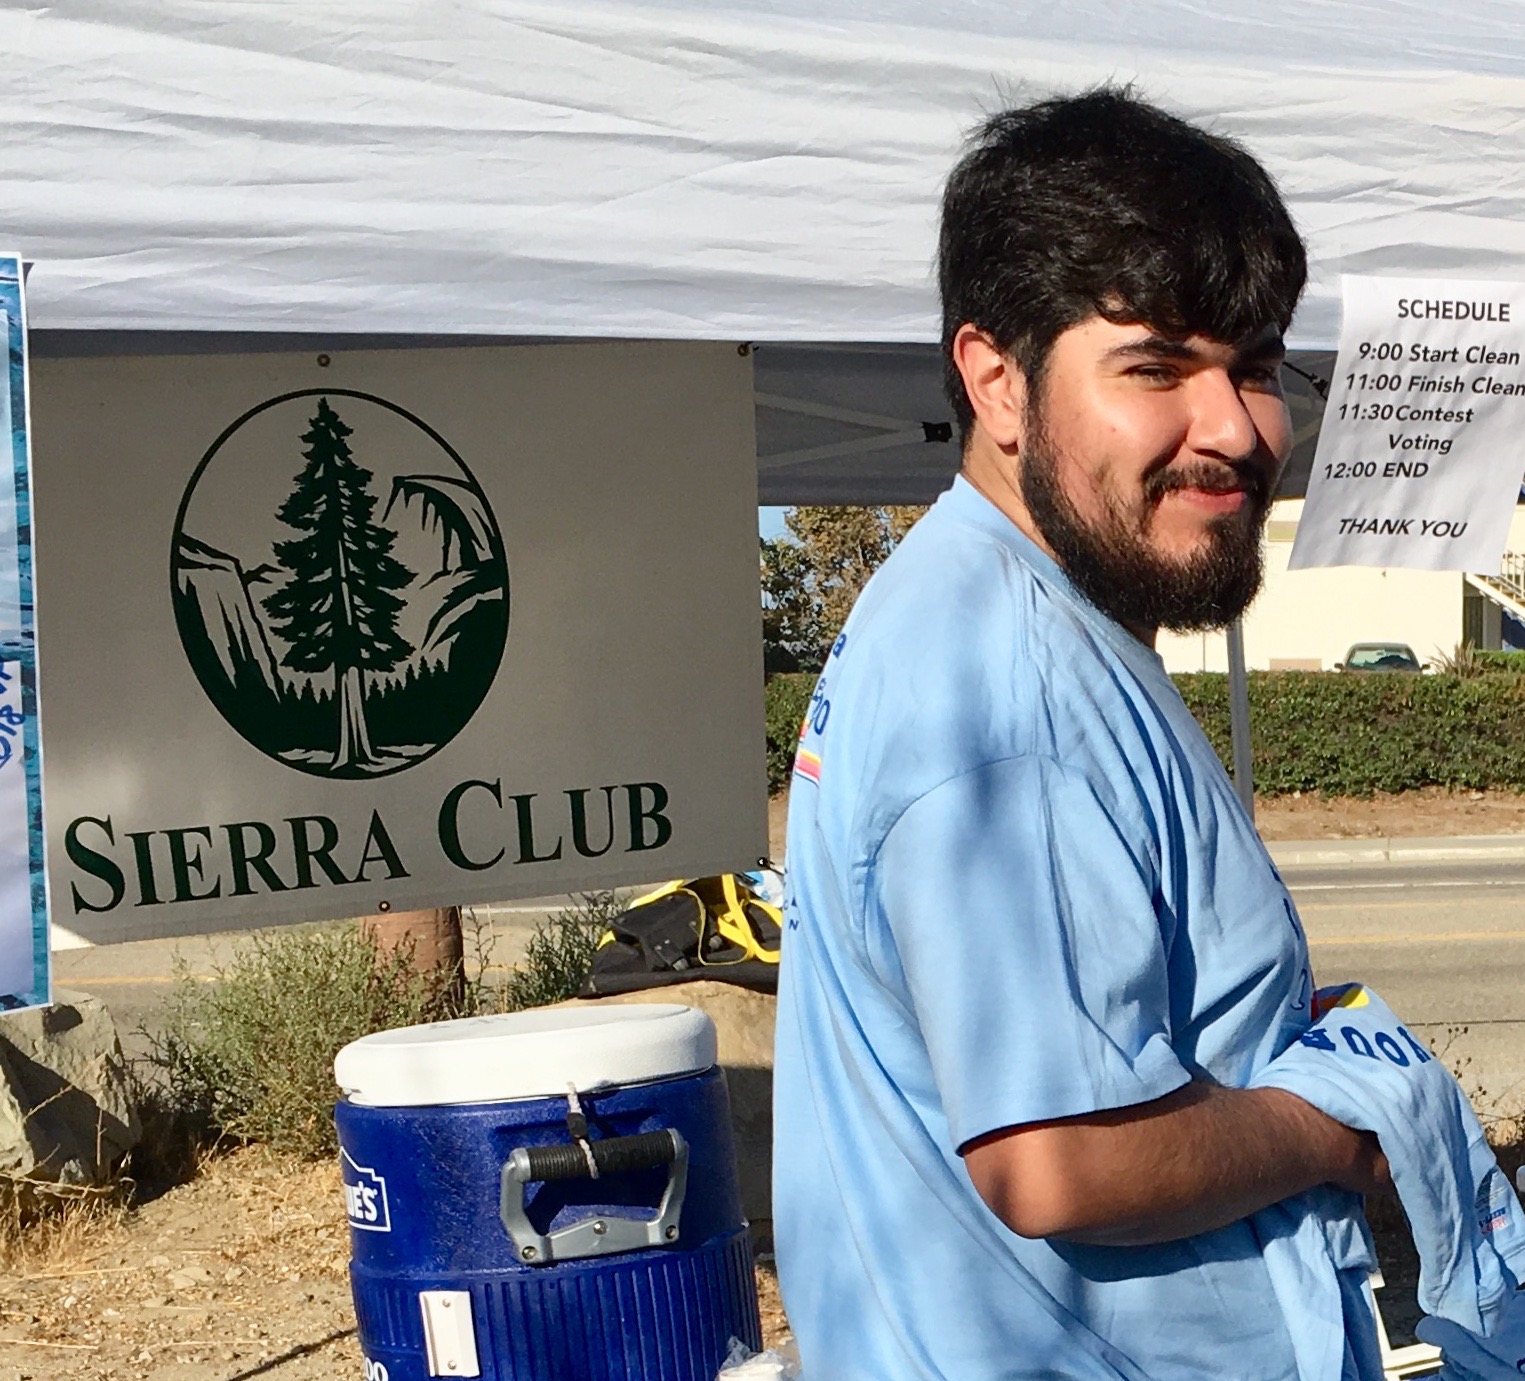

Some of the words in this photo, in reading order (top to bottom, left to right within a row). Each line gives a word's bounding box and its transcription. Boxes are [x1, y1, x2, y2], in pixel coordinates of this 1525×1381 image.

[1398, 299, 1510, 322] SCHEDULE
[1358, 342, 1402, 361] 9:00
[1409, 343, 1459, 362] Start
[1466, 346, 1520, 365] Clean
[1346, 374, 1401, 391] 11:00
[1408, 375, 1464, 393] Finish
[1471, 377, 1525, 396] Clean
[1339, 404, 1395, 421] 11:30
[1396, 405, 1473, 423] Contest
[1388, 434, 1453, 455] Voting
[1324, 462, 1376, 479] 12:00
[1382, 462, 1429, 478] END
[1338, 519, 1414, 535] THANK
[1421, 520, 1468, 538] YOU
[64, 808, 411, 914] SIERRA
[438, 778, 672, 872] CLUB
